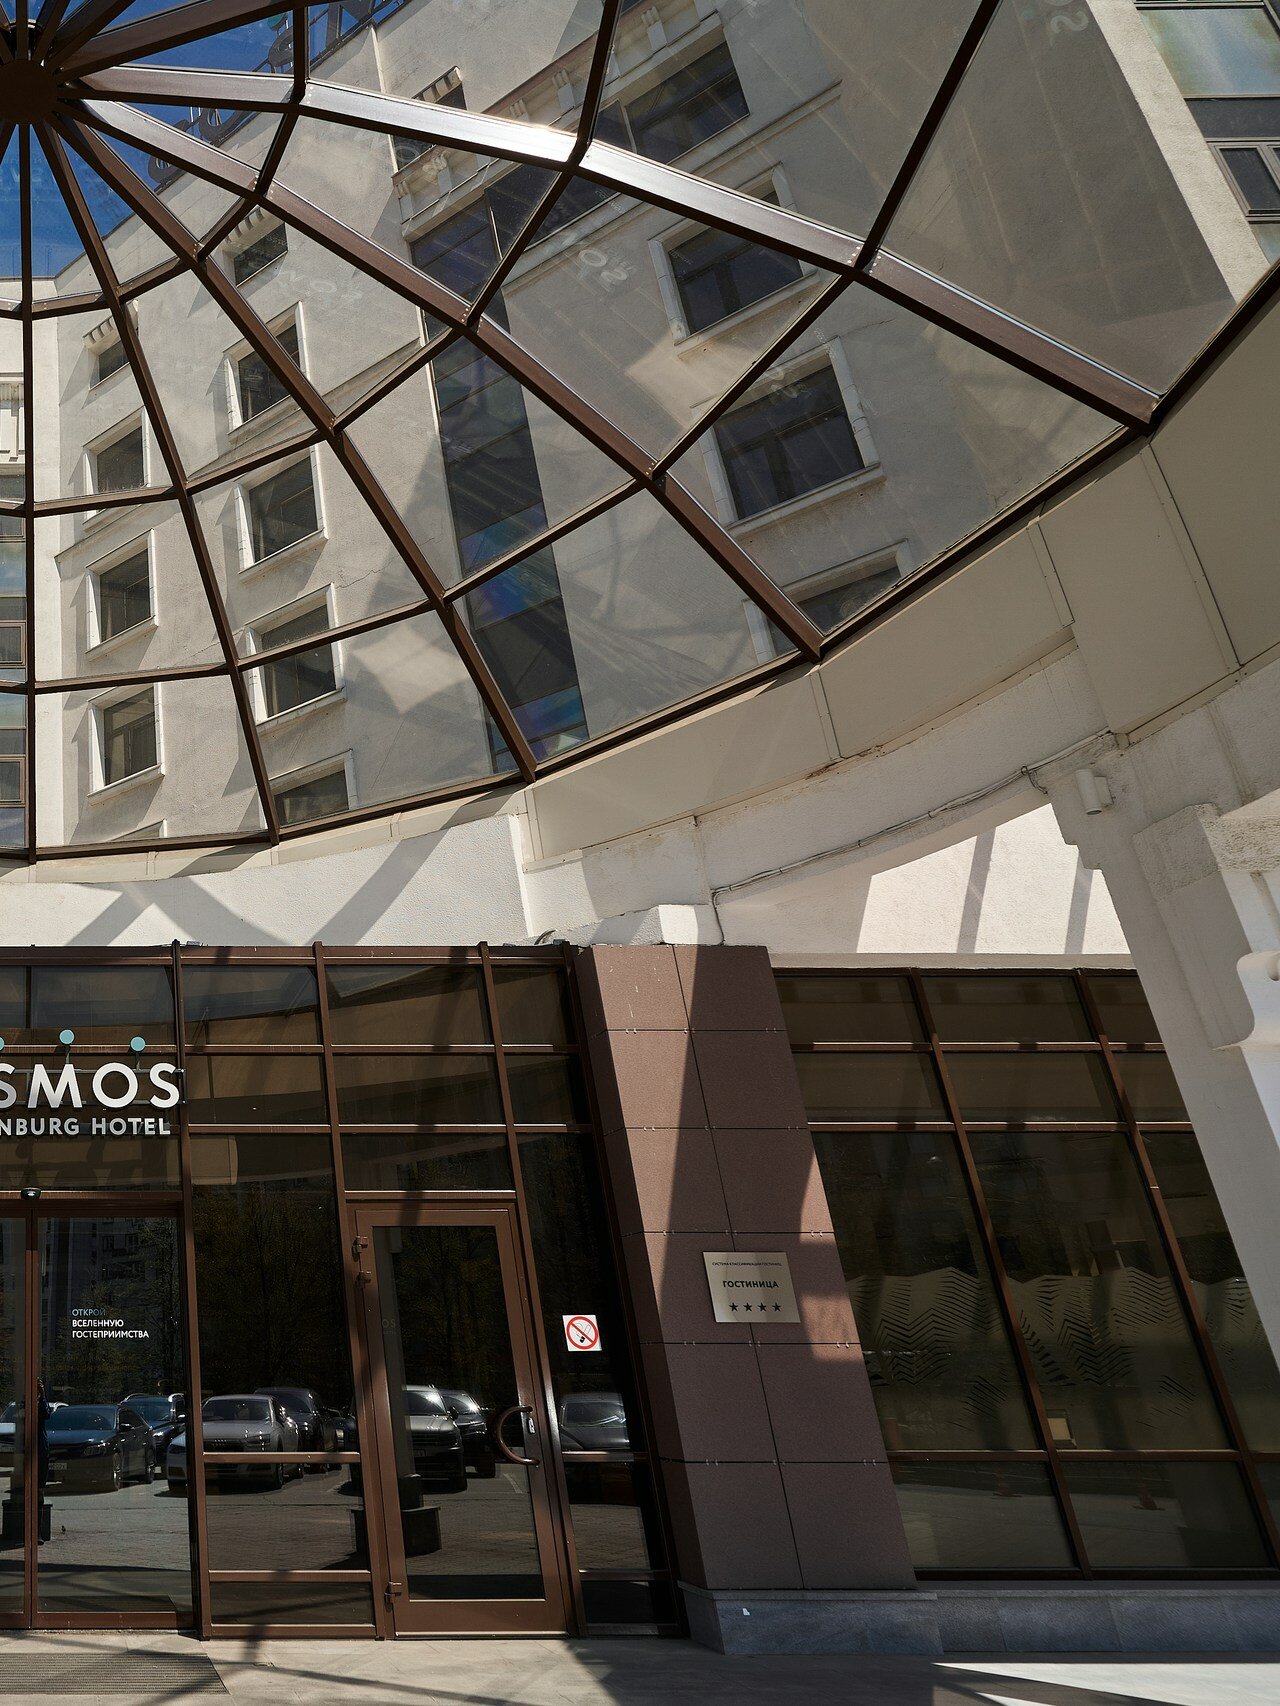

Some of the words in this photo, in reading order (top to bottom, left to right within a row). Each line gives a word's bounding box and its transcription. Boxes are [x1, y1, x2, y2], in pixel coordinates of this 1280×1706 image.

[91, 1117, 171, 1136] HOTEL
[722, 1280, 779, 1289] ГОСТИНИЦА
[72, 1308, 106, 1316] ОТКРОЙ
[72, 1319, 124, 1327] ВСЕЛЕННУЮ
[72, 1330, 150, 1338] ГОСТЕПРИИМСТВА
